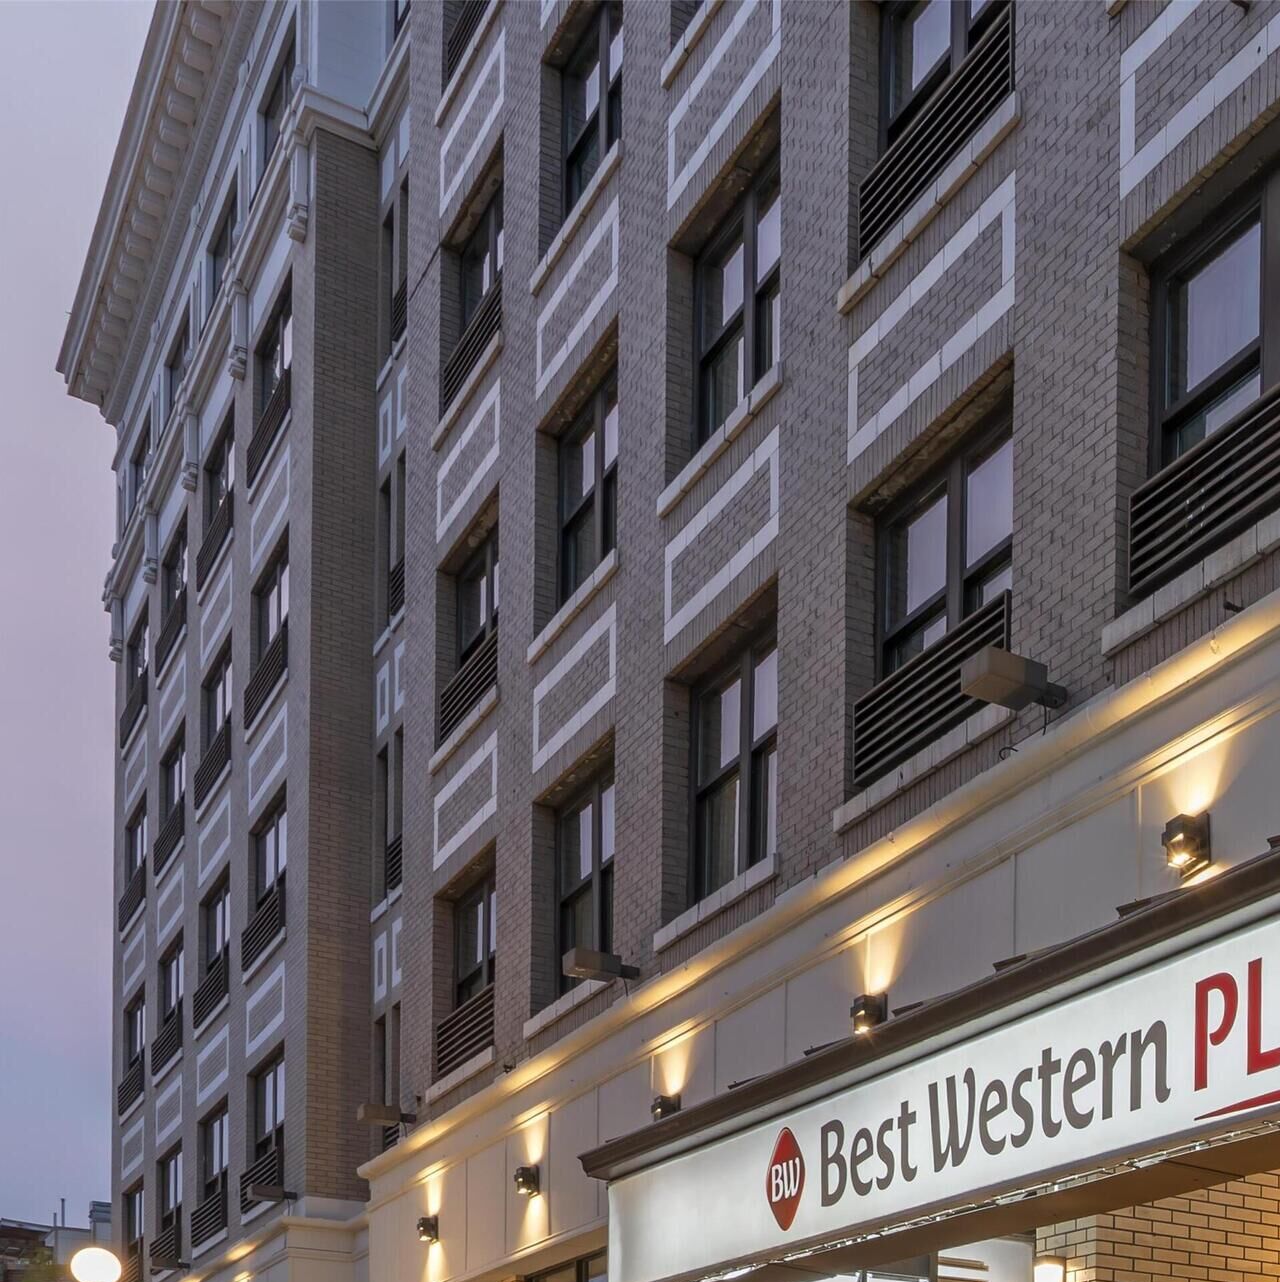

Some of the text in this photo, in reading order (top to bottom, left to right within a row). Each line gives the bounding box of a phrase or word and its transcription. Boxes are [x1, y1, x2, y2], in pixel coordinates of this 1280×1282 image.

[771, 1157, 800, 1203] BW
[820, 1100, 918, 1207] Best
[928, 1019, 1171, 1173] Western
